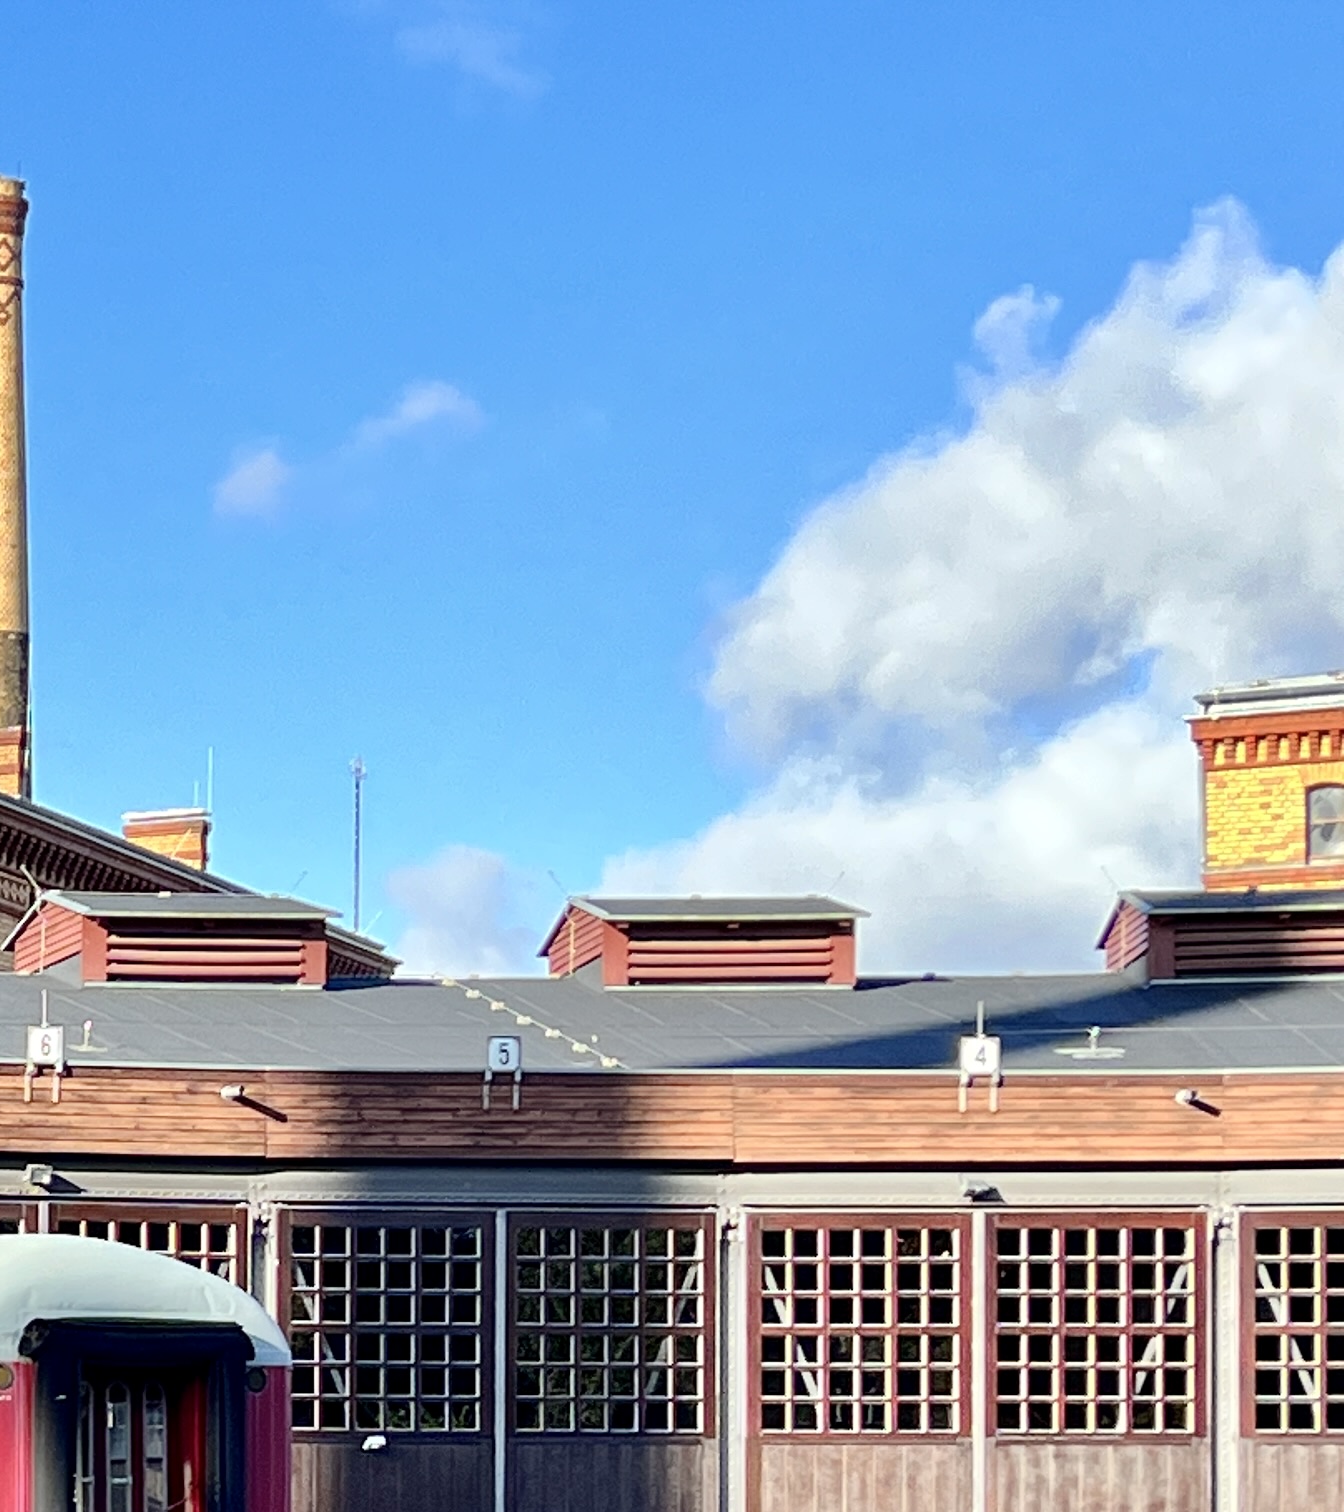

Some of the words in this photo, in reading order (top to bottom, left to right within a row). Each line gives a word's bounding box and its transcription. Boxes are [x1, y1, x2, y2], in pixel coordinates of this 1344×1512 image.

[40, 1033, 51, 1056] 6
[499, 1044, 510, 1066] 5
[974, 1044, 986, 1067] 4
